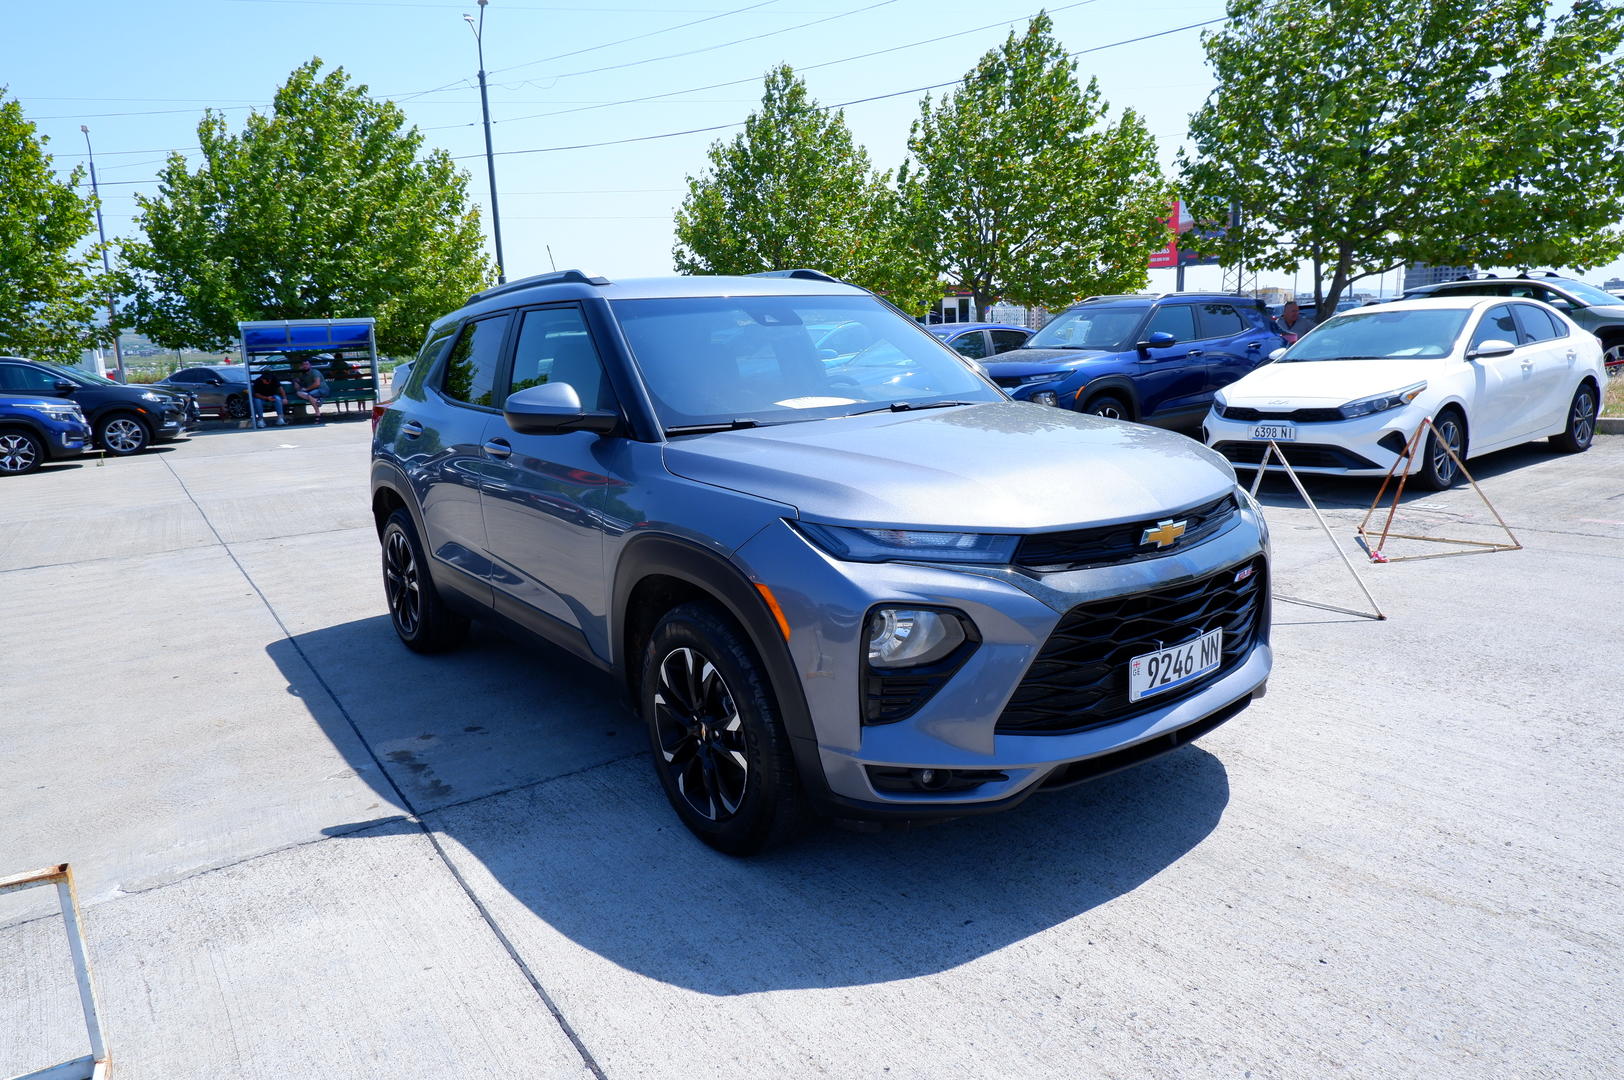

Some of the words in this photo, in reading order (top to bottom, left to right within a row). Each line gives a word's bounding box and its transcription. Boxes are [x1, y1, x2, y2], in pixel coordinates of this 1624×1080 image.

[1254, 427, 1277, 438] 6398
[1281, 427, 1292, 438] NI
[1147, 645, 1194, 689] 9246
[1200, 633, 1220, 669] NN
